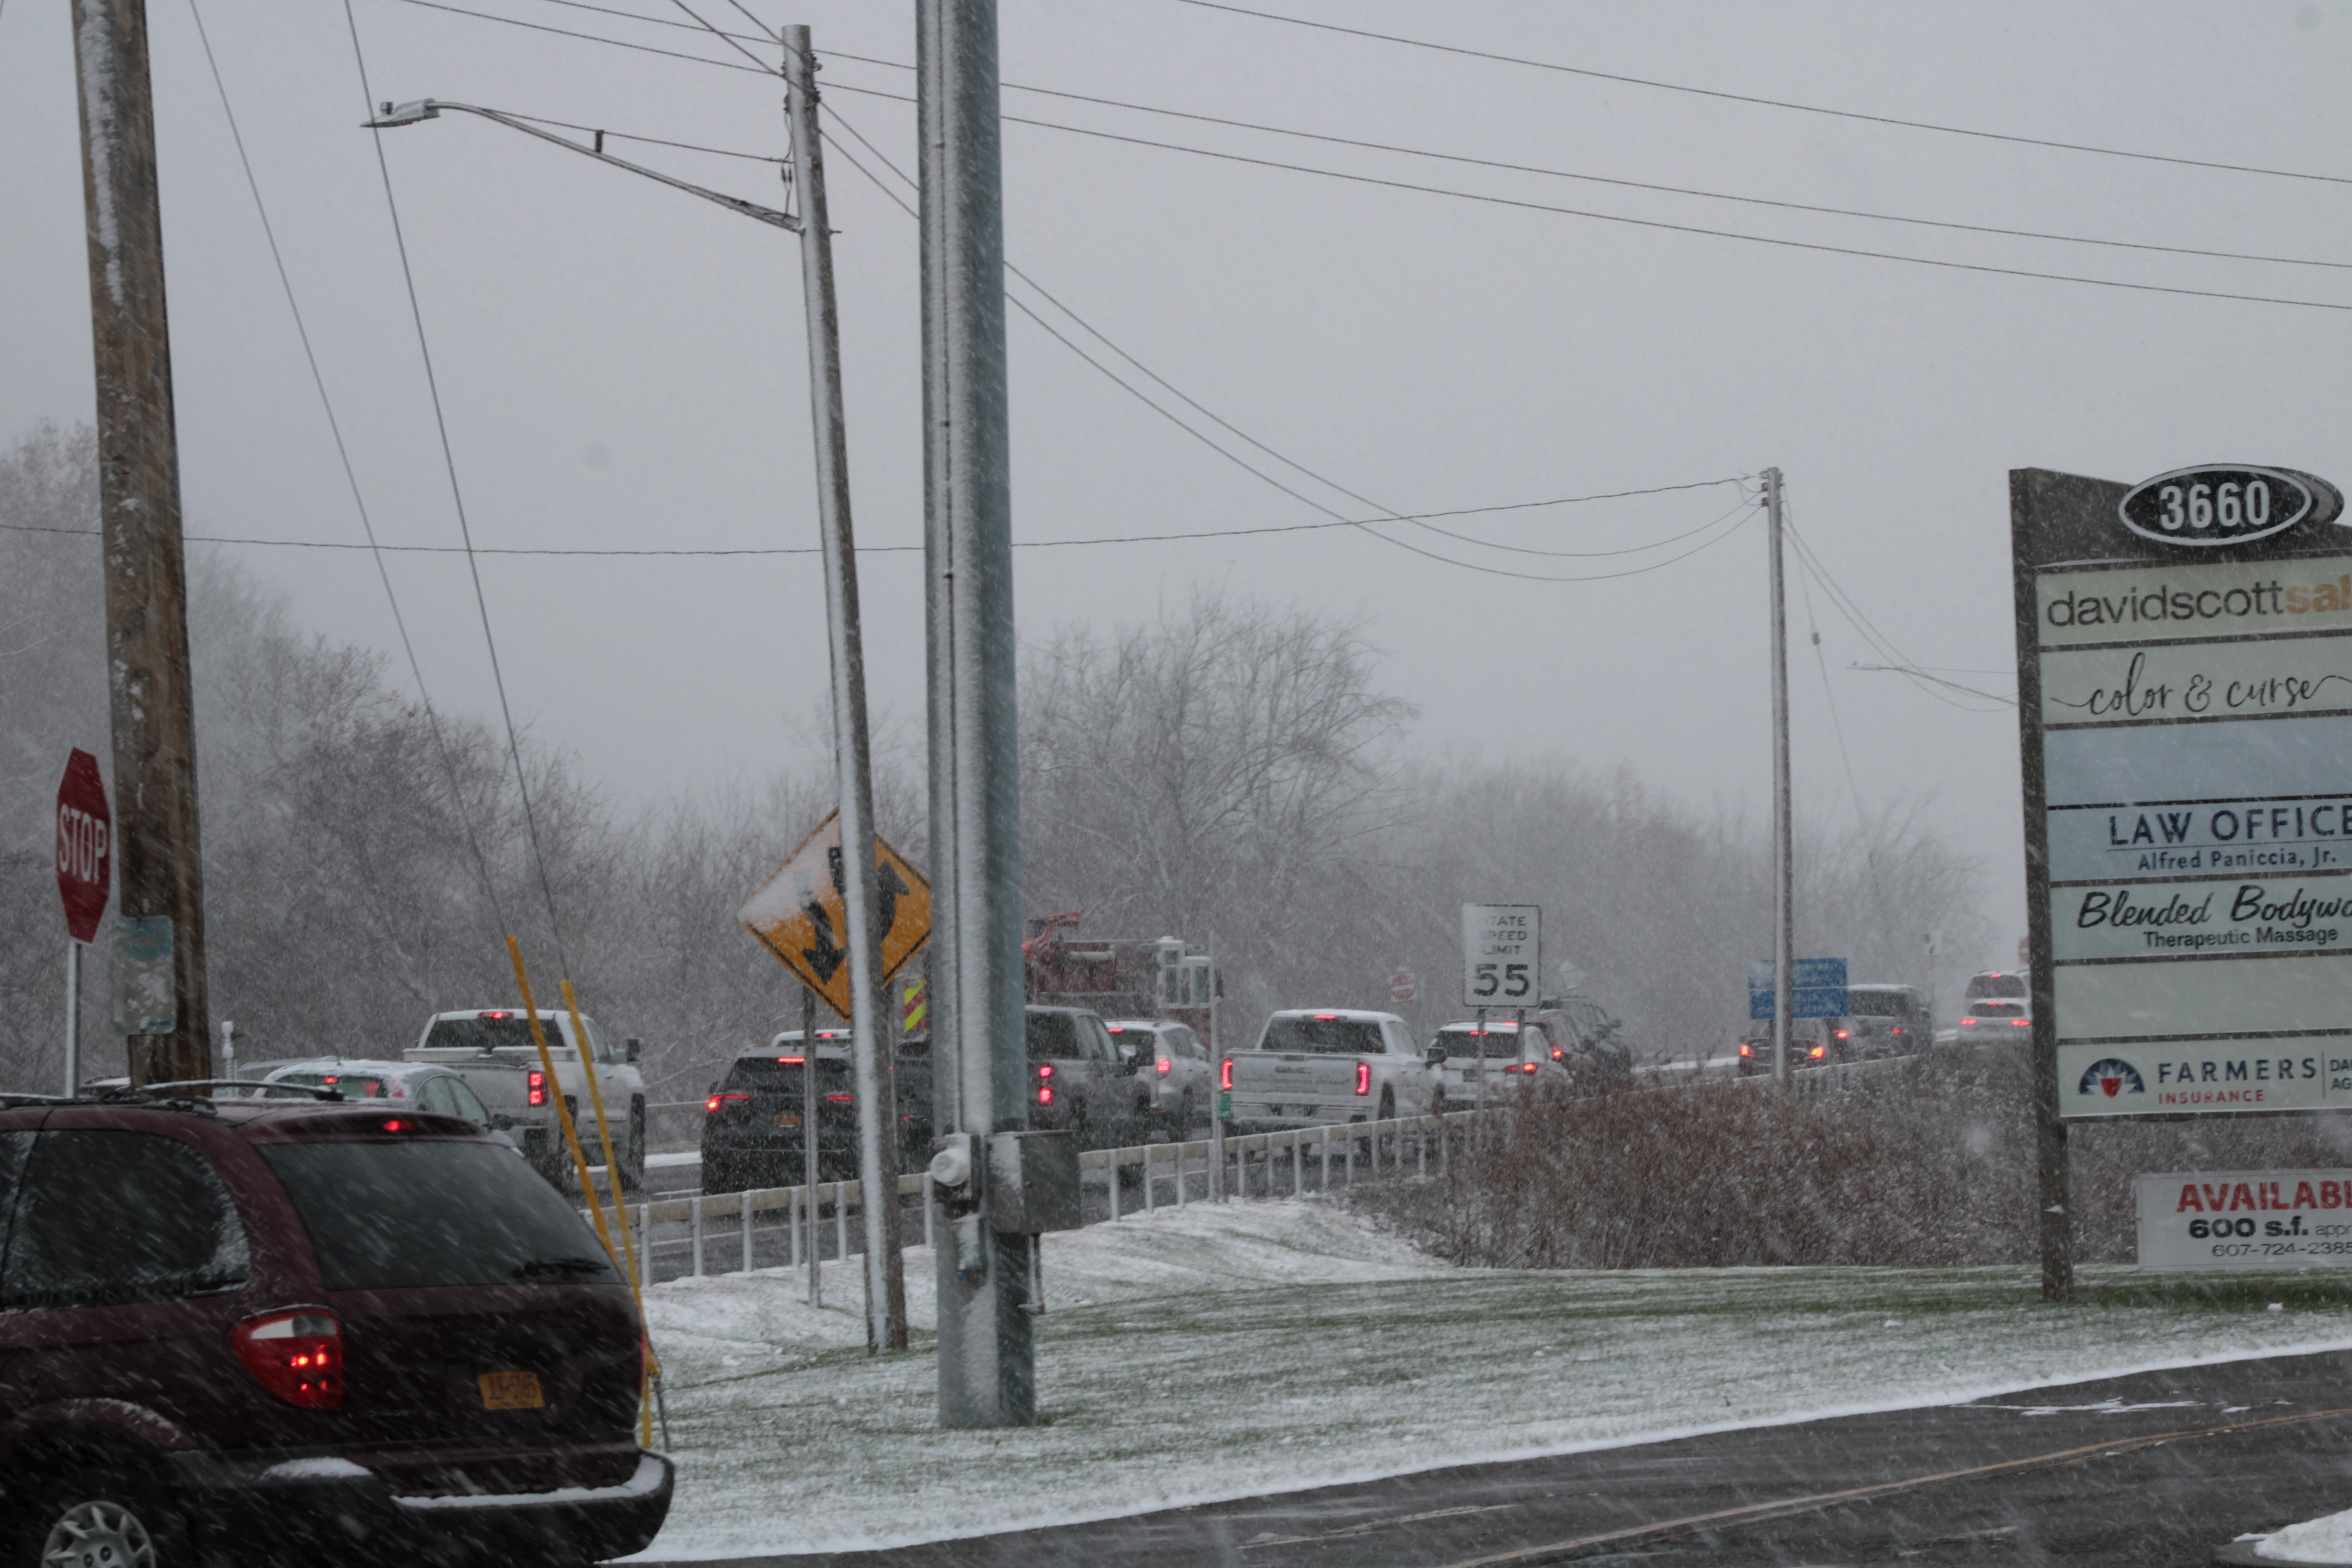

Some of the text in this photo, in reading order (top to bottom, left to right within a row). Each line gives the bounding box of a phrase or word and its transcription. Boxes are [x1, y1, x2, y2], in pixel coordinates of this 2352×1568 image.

[2159, 481, 2269, 530] 3660
[2050, 652, 2352, 716] color & curse
[2109, 805, 2352, 845] LAW OFFICE
[58, 804, 107, 885] STOP
[2138, 847, 2336, 871] Alfred Paniccia, Jr.
[1481, 916, 1526, 926] TATE
[2078, 890, 2214, 928] Blended
[2143, 926, 2337, 949] Therapeutic Massage
[1473, 963, 1531, 996] 55
[2158, 1058, 2317, 1083] FARMERS
[2330, 1059, 2352, 1071] DA
[2158, 1089, 2265, 1105] INSURANCE
[2189, 1218, 2256, 1239] 600
[2265, 1216, 2308, 1236] s.f.
